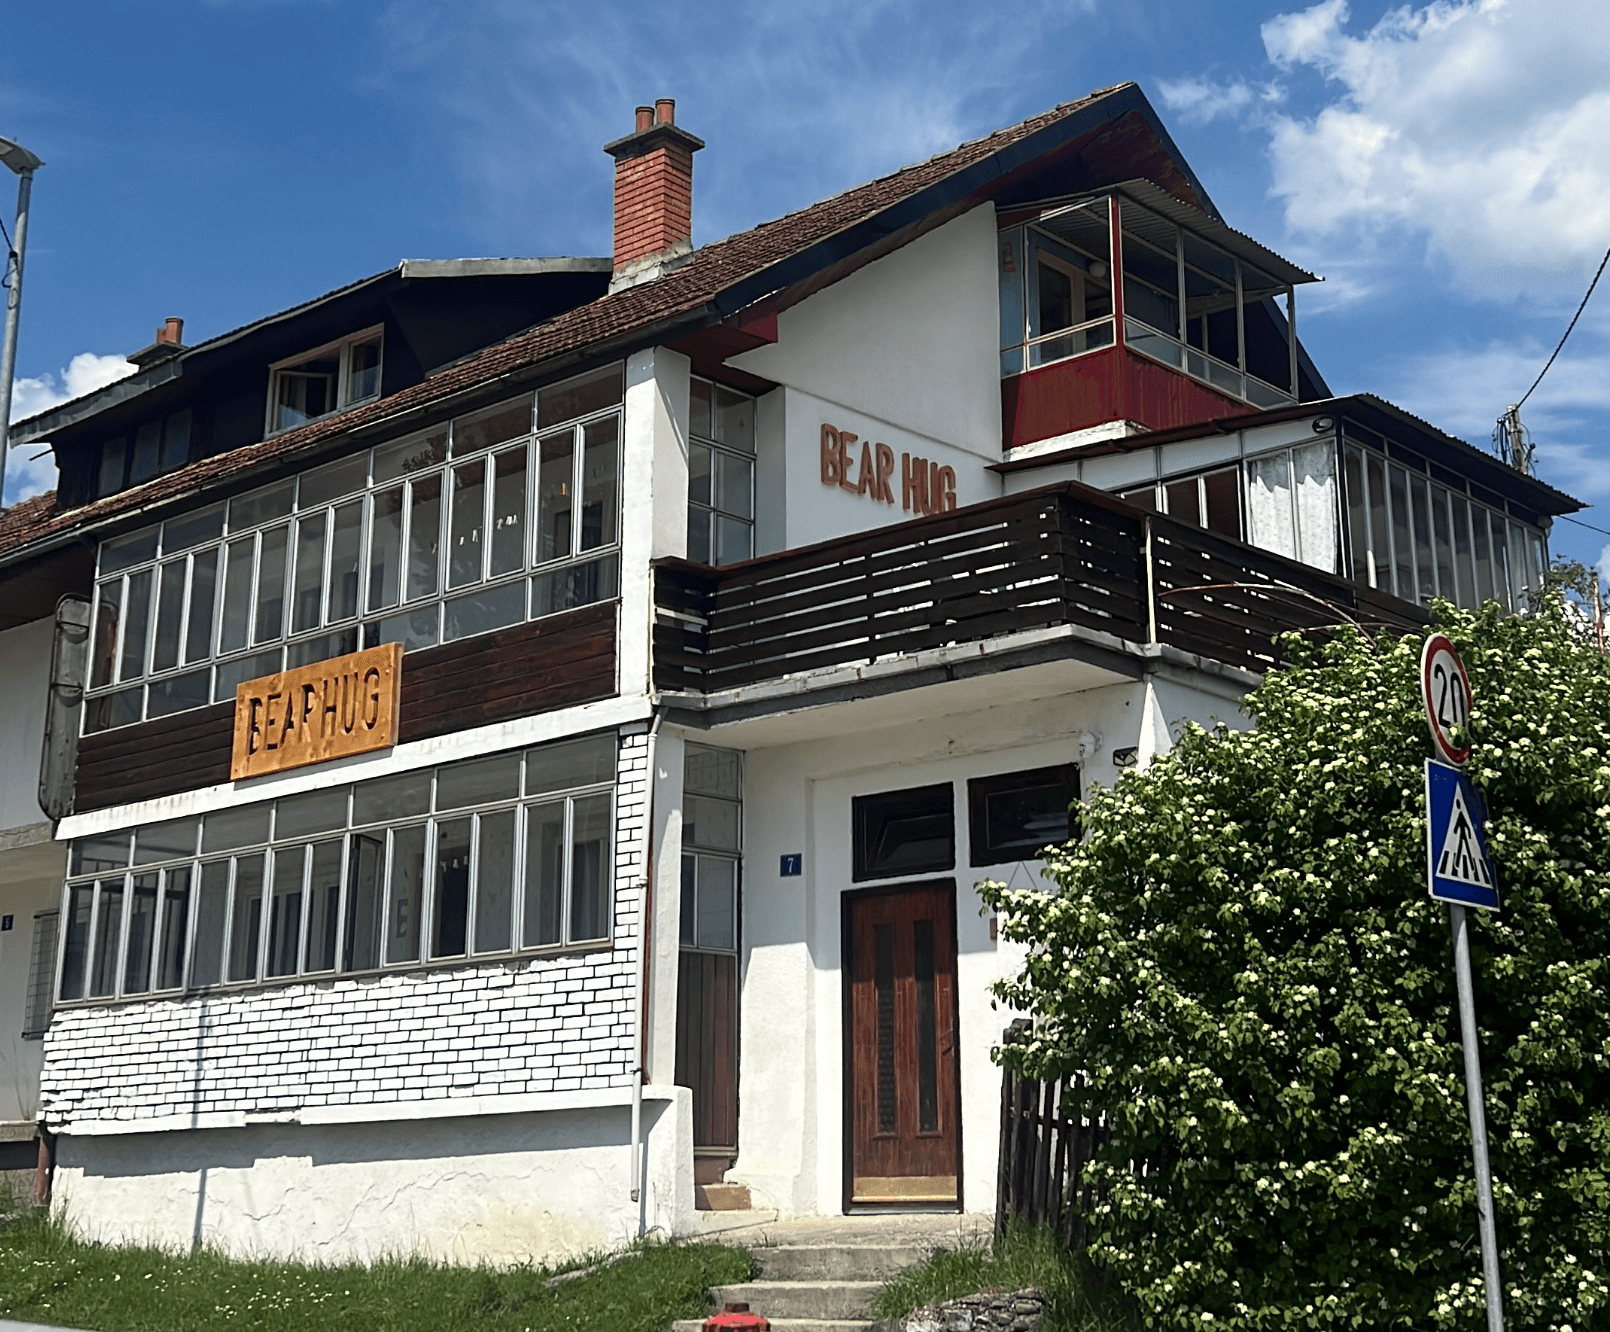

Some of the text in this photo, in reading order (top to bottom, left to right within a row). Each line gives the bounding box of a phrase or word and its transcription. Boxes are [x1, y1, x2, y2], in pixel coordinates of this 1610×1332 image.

[820, 422, 957, 516] BEAR HUG
[787, 857, 794, 873] 7
